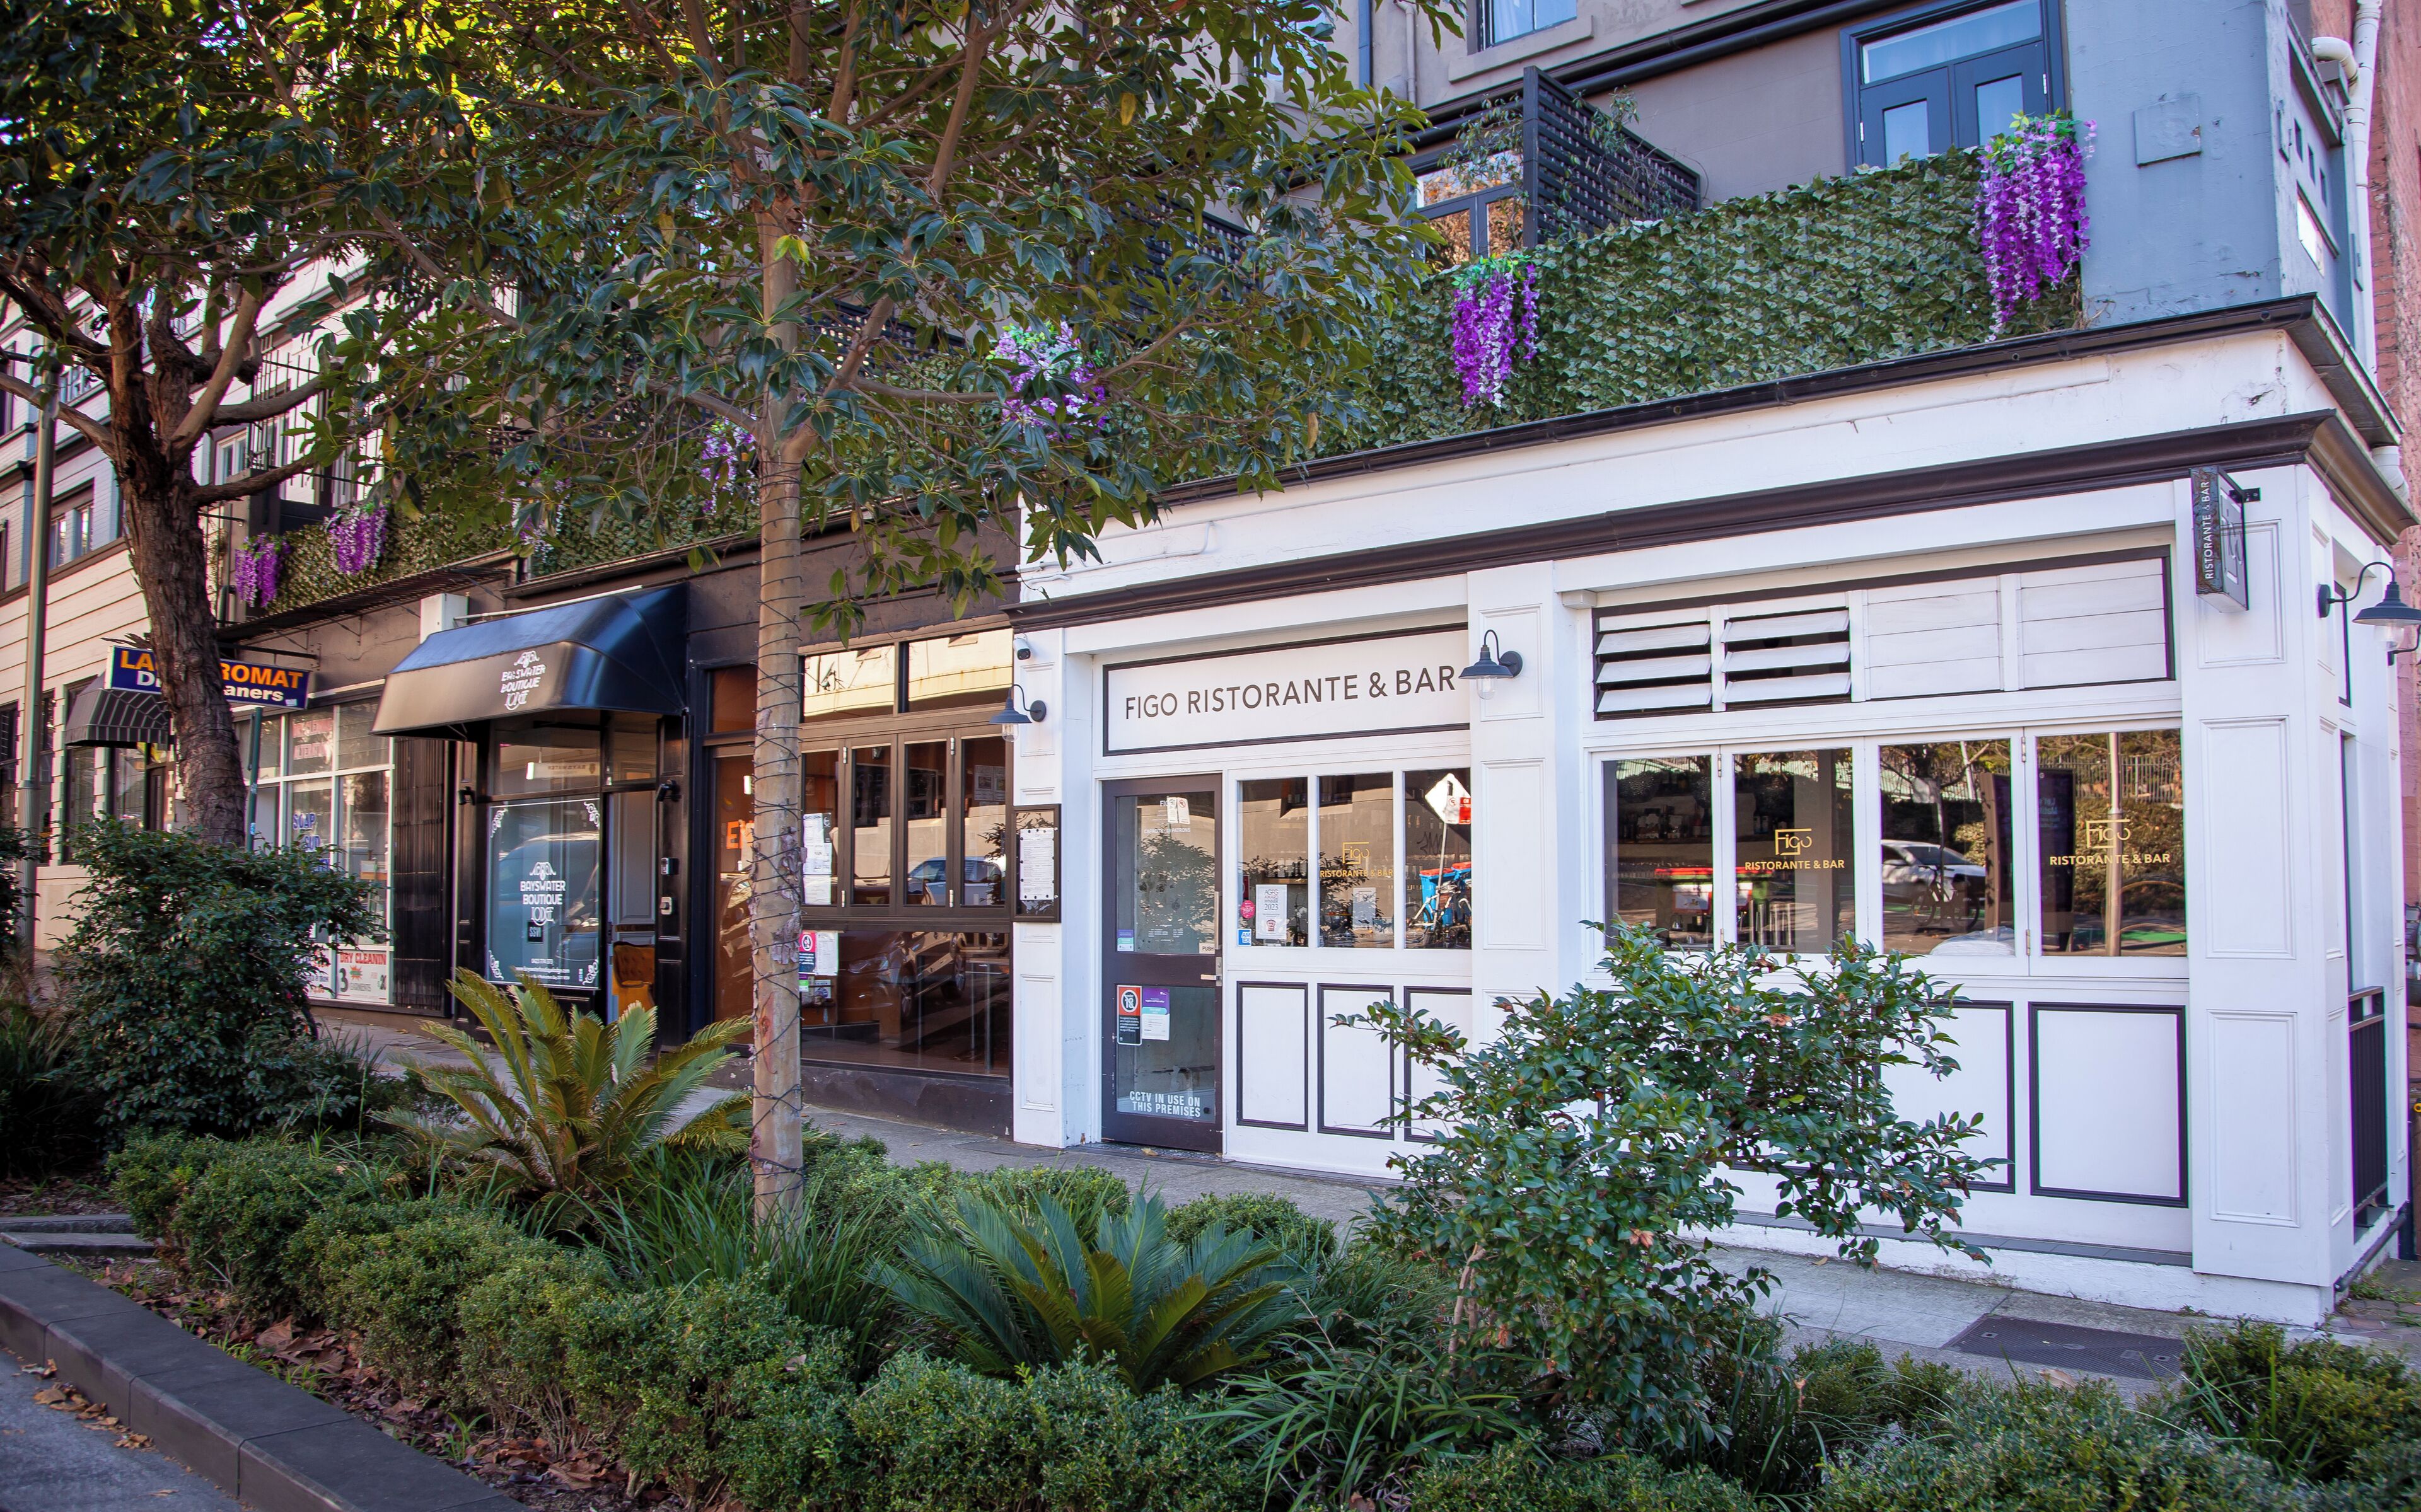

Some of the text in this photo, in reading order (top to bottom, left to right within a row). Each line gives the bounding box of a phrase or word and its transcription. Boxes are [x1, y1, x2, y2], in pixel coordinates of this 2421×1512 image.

[2200, 481, 2210, 502] BAR
[2202, 514, 2214, 579] RISTORANTE
[120, 650, 303, 688] LAROMAT
[223, 684, 283, 701] aners
[1125, 666, 1456, 719] FIGO RISTORANTE & BAR
[293, 812, 315, 829] SOAP
[1775, 828, 1813, 856] Figo
[2086, 819, 2131, 849] Figo
[1342, 841, 1370, 864] Figo
[2050, 853, 2171, 865] RISTORANTE & BAR
[1320, 869, 1368, 877] RISTORANTE
[1745, 860, 1845, 870] RISTORANTE & BAR
[520, 880, 566, 891] BAYSWATER
[523, 894, 563, 904] BOUTIQUE
[531, 907, 555, 926] LODGE
[340, 952, 353, 963] DRY
[339, 967, 349, 993] 3
[1125, 998, 1134, 1008] 18
[1129, 1091, 1200, 1107] CCTV IN USE ON
[1132, 1101, 1200, 1117] THIS PREMISES
